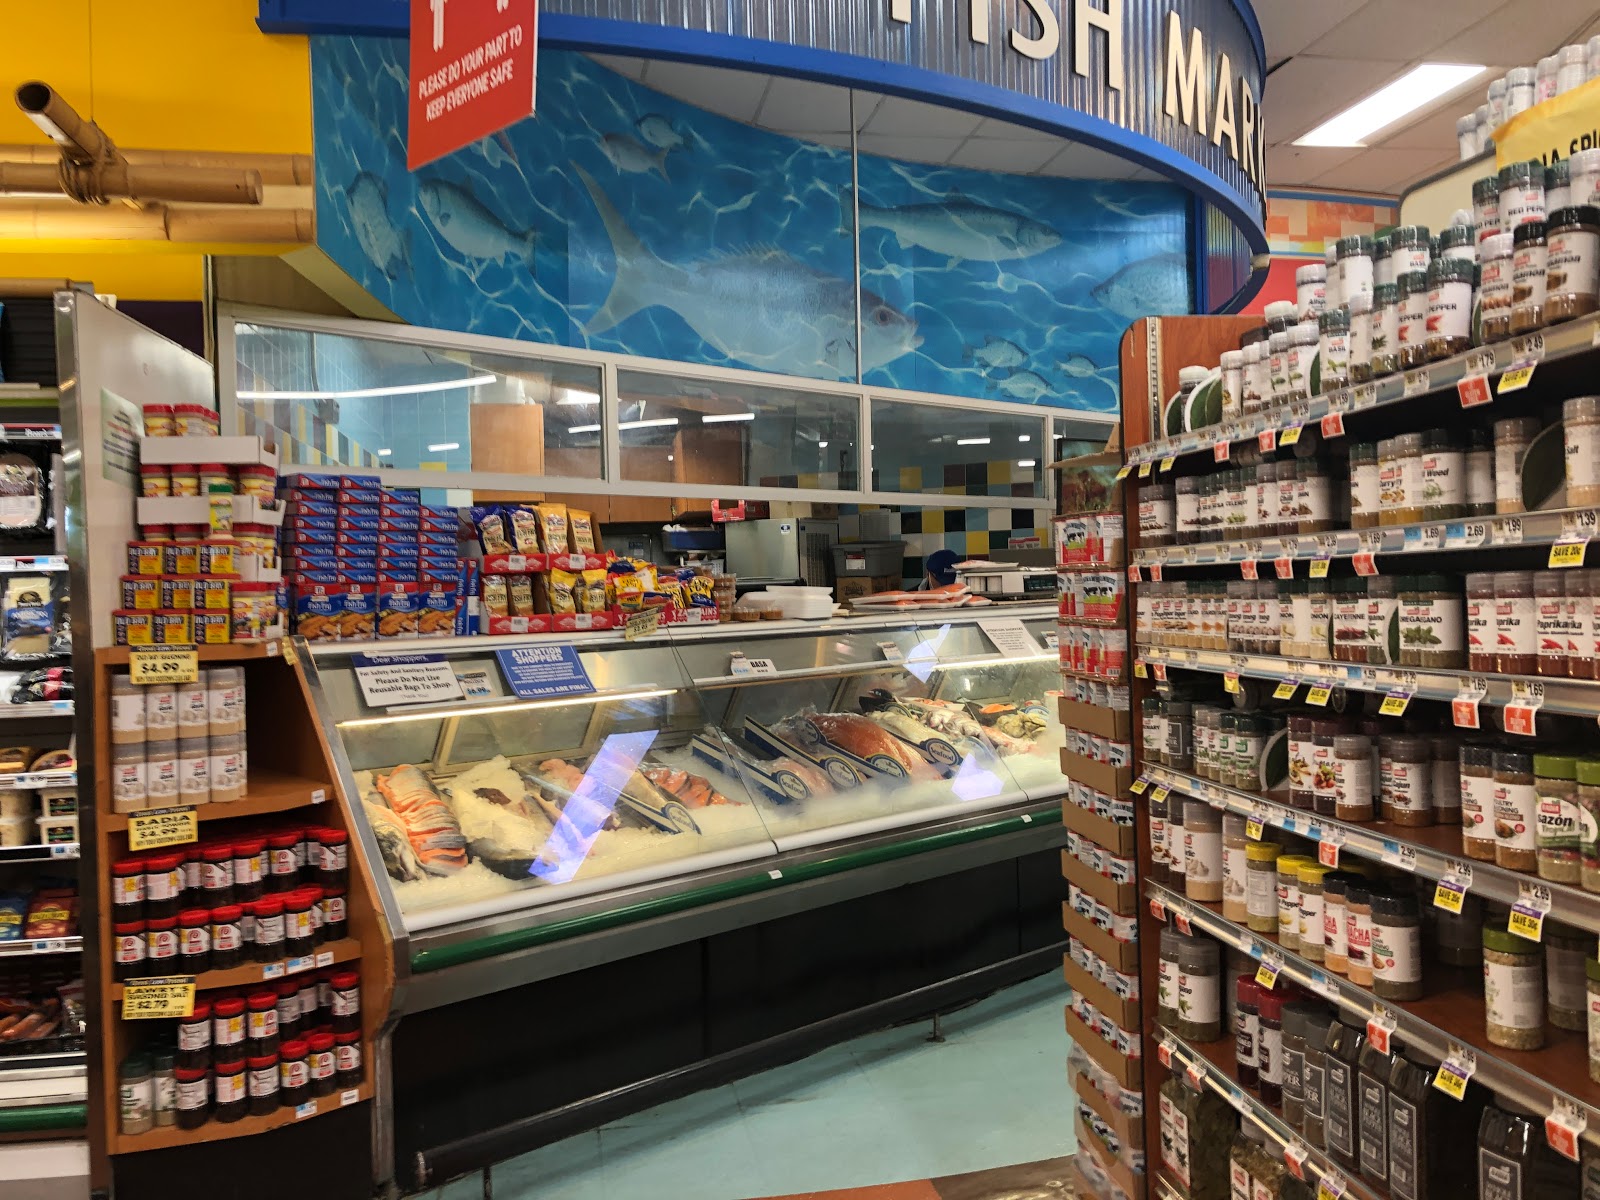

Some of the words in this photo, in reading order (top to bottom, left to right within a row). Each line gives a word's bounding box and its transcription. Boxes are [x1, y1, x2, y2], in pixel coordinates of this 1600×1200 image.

[419, 67, 447, 100] PLEASE
[448, 60, 460, 83] DO
[461, 46, 484, 76] YOUR
[485, 32, 508, 63] PART
[509, 24, 522, 49] TO
[426, 95, 445, 122] KEEP
[446, 71, 489, 112] EVERYONE
[490, 58, 514, 88] SAFE
[1400, 312, 1424, 322] EPPER
[1554, 546, 1570, 557] SAVE
[511, 646, 562, 658] ATTENTION
[372, 656, 390, 665] Dear
[515, 654, 563, 665] SHOPPERS
[375, 676, 399, 684] Please
[369, 685, 402, 694] Reusable
[404, 684, 420, 692] Bags
[136, 815, 190, 826] BADIA
[1538, 814, 1573, 827] sazón
